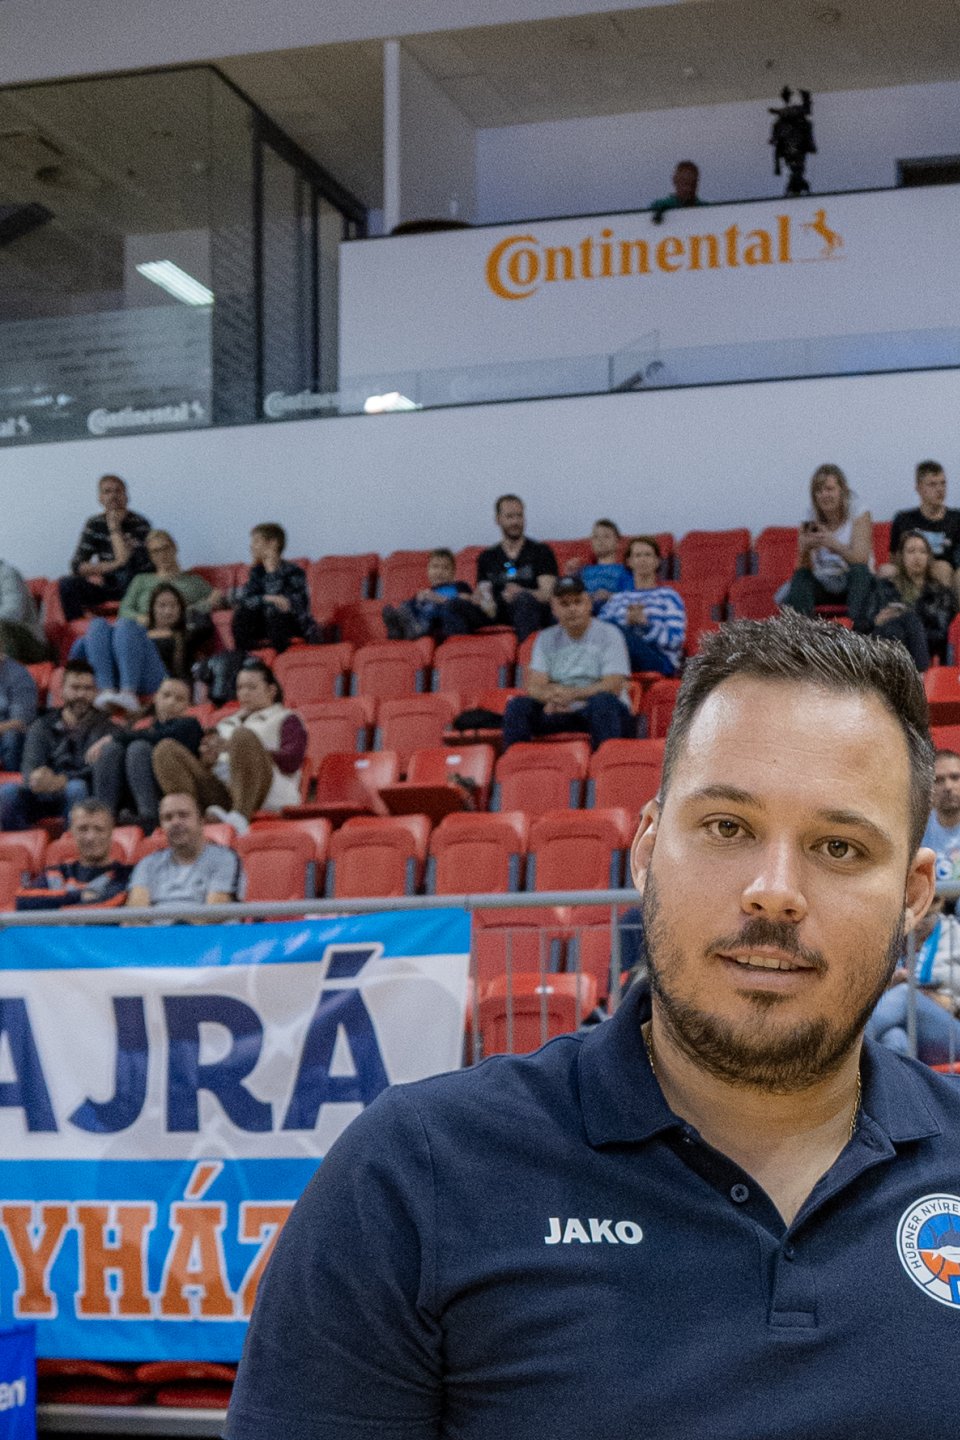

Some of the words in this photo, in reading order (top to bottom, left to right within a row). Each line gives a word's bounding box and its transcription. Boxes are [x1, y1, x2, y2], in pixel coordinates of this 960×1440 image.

[486, 215, 790, 300] Continental
[87, 402, 190, 435] Continental
[544, 1216, 643, 1245] JAKO
[904, 1214, 922, 1270] HÜBNER
